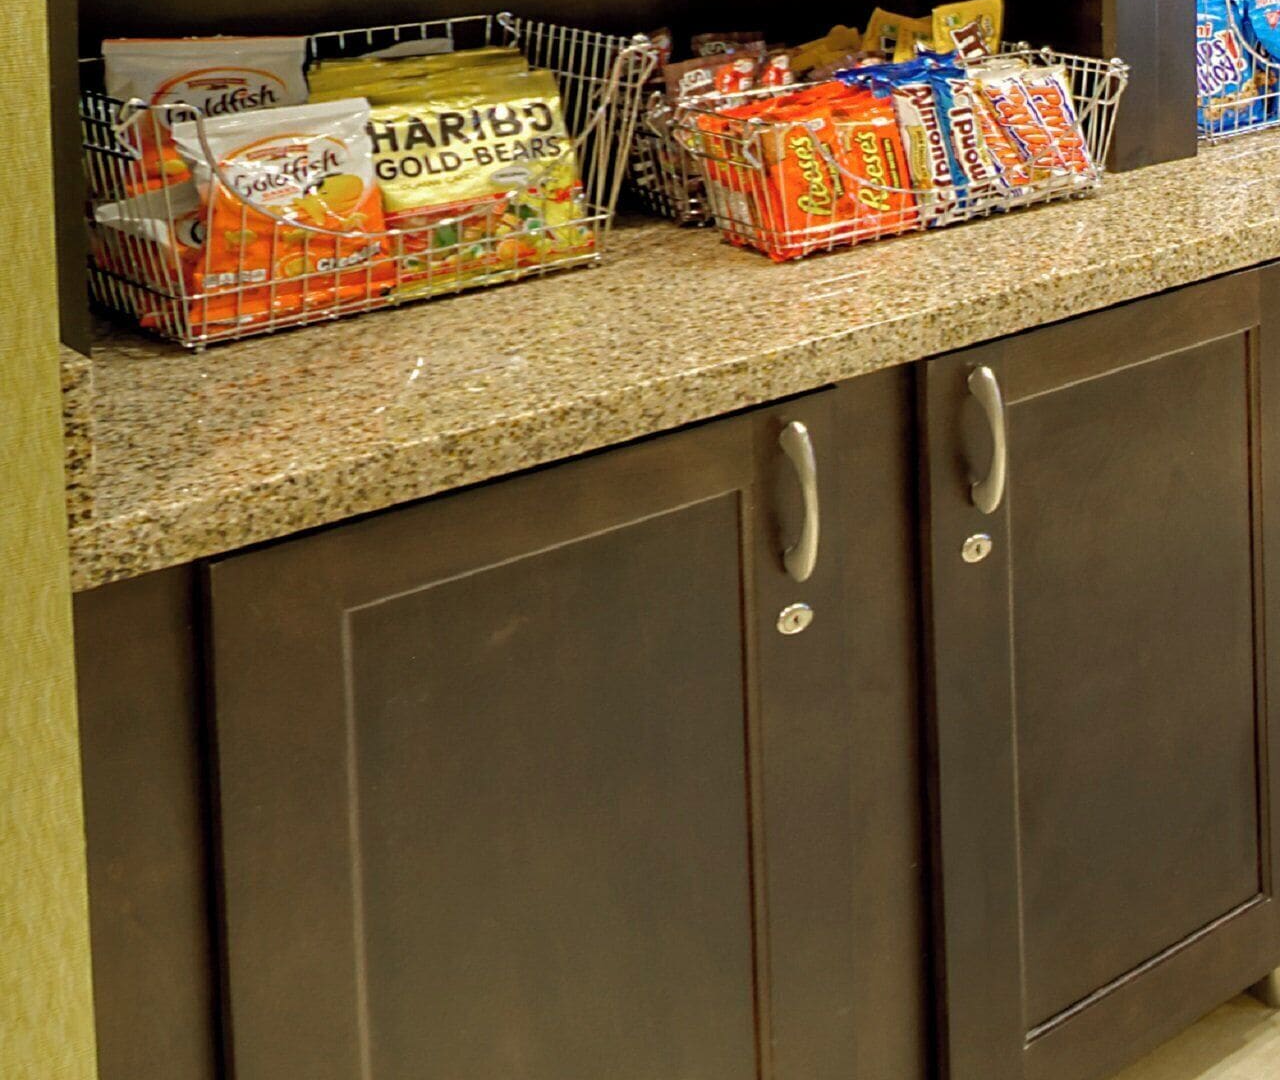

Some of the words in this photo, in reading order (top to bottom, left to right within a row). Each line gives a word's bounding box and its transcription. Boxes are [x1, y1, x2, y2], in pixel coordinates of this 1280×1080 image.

[366, 102, 554, 155] HARIBO
[375, 135, 562, 181] GOLD-BEARS
[894, 84, 950, 177] Almond
[788, 136, 833, 216] Reese's
[854, 130, 891, 212] Reese's
